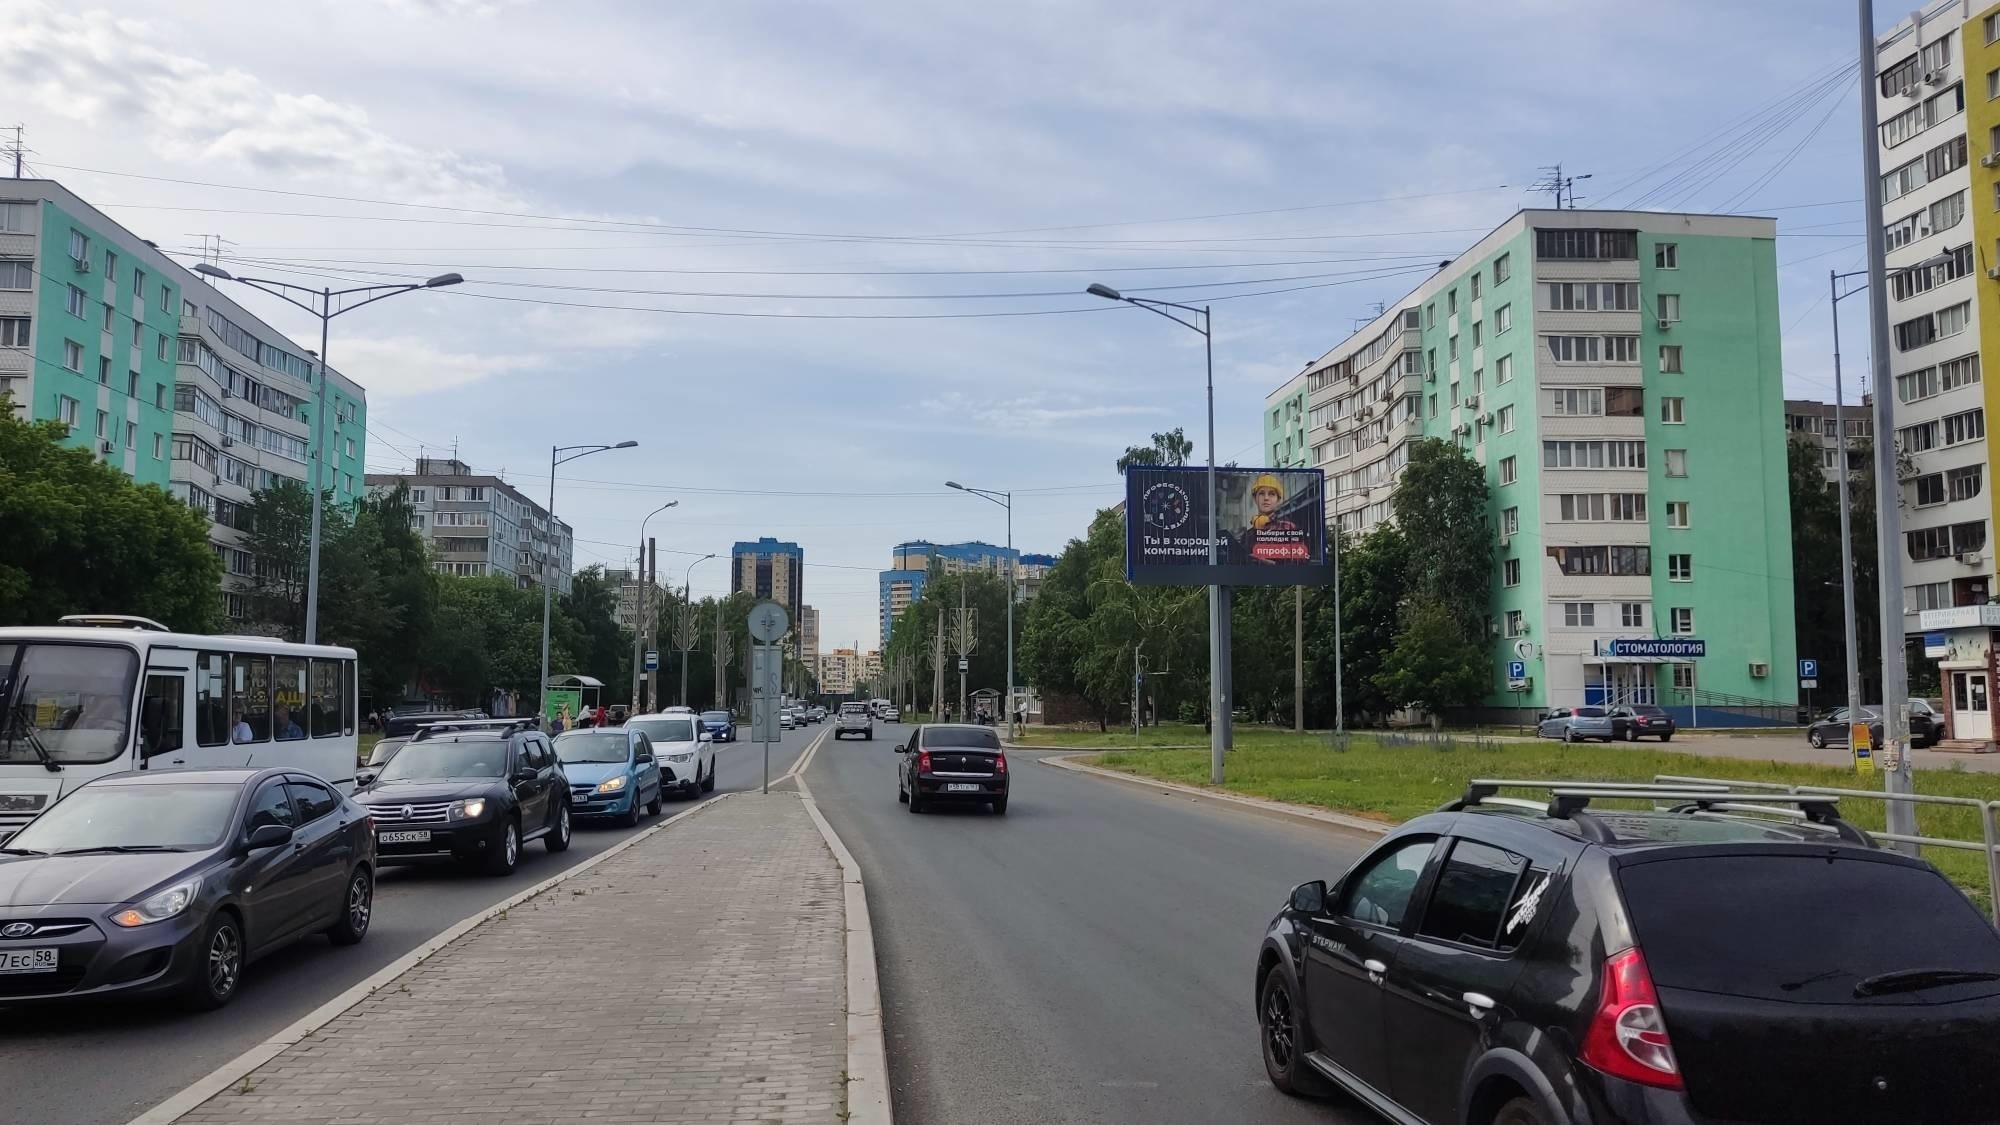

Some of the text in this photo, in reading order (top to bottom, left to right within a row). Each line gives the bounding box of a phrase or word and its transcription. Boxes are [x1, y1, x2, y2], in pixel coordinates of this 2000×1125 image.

[1256, 529, 1285, 537] Выбери
[1144, 535, 1160, 545] Ты
[1144, 546, 1209, 556] компании!
[1256, 546, 1305, 557] ппроф.рф
[1616, 643, 1704, 654] СТОМАТОЛОГИЯ
